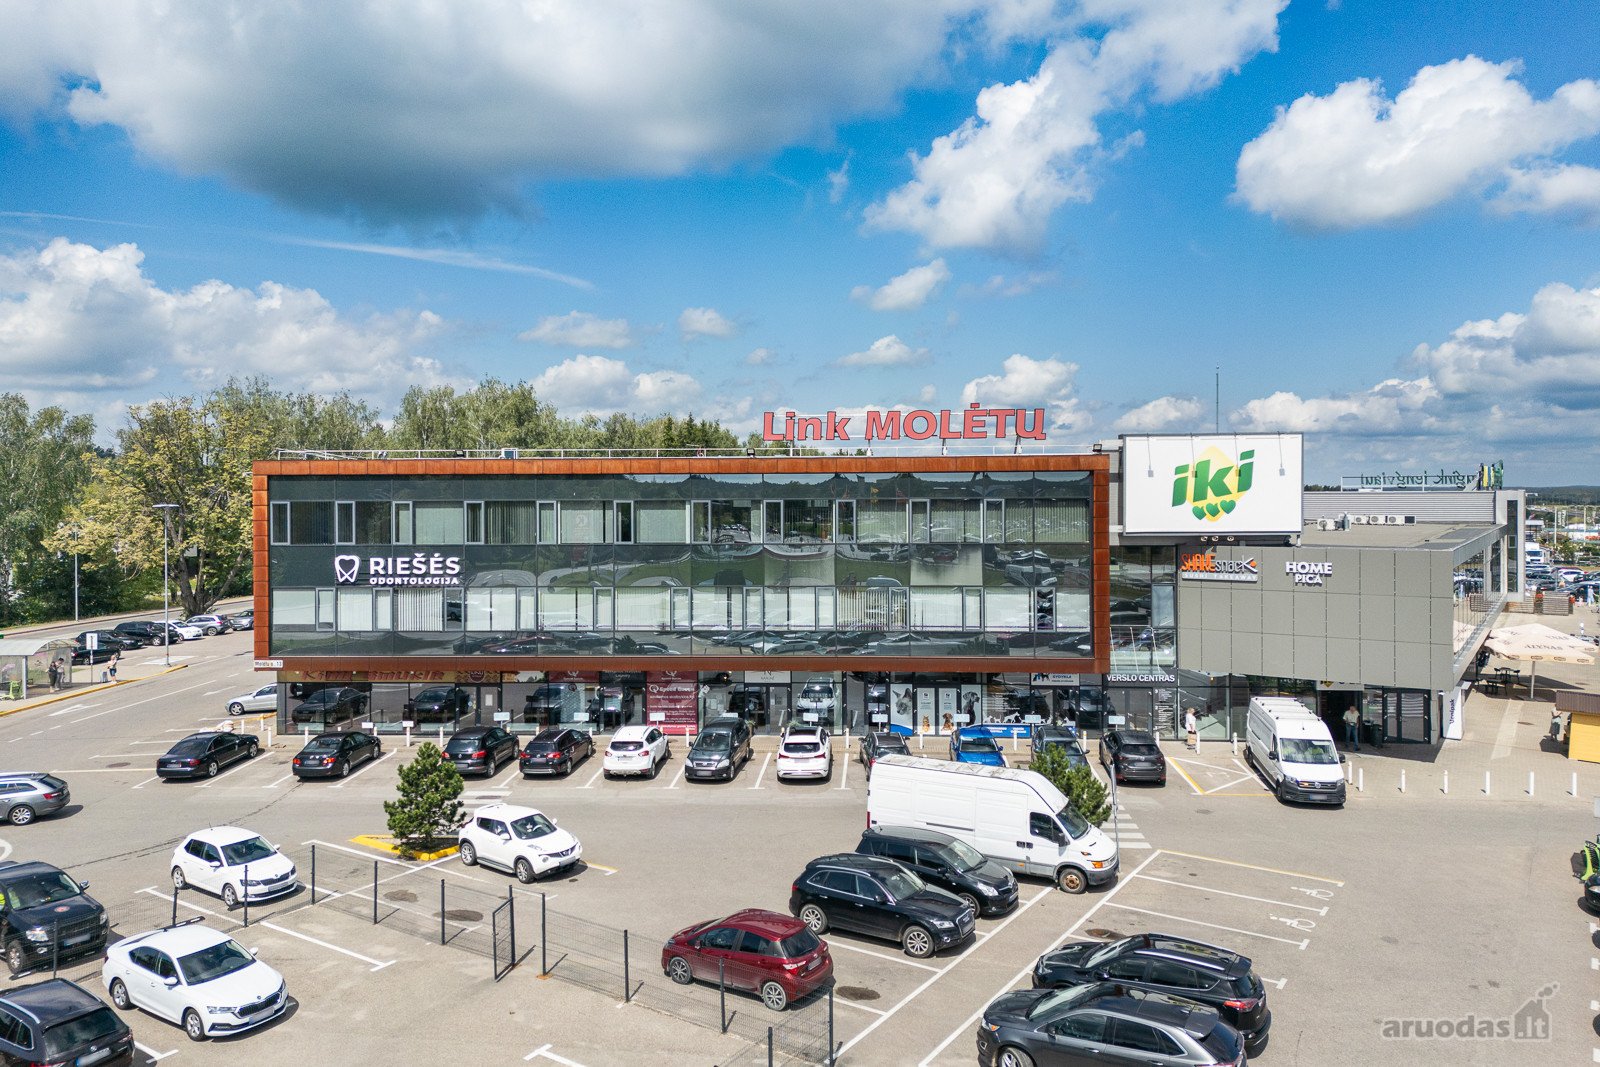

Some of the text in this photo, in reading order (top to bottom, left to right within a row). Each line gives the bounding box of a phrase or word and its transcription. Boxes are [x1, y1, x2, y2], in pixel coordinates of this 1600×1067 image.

[763, 403, 1047, 441] Link MOLĖTŲ
[1172, 449, 1255, 507] iki
[369, 552, 460, 575] RIEŠĖS
[1285, 561, 1333, 575] HOME
[369, 577, 459, 585] ODONTOLOGIJA
[1294, 574, 1323, 584] PICA
[1107, 674, 1176, 682] VERSLO CENTRAS
